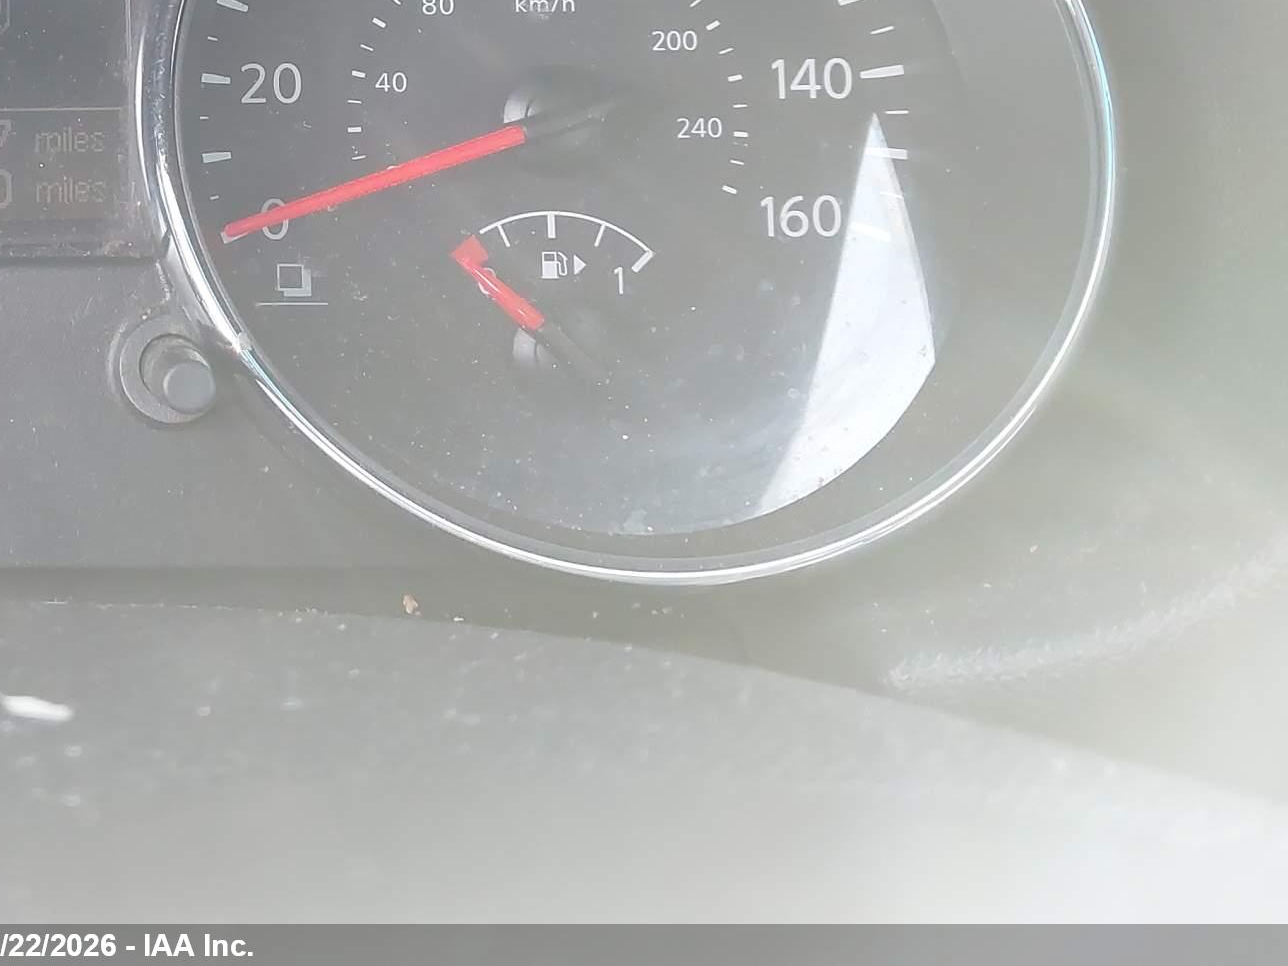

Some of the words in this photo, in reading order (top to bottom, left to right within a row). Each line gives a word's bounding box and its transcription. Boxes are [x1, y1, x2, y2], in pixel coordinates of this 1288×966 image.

[651, 30, 698, 52] 200
[240, 62, 302, 104] 20
[375, 72, 408, 94] 40
[771, 57, 853, 100] 140
[35, 126, 105, 154] miles
[676, 117, 723, 139] 240
[35, 176, 106, 204] miles
[261, 198, 289, 240] 0
[760, 195, 843, 238] 160
[614, 266, 624, 295] 1
